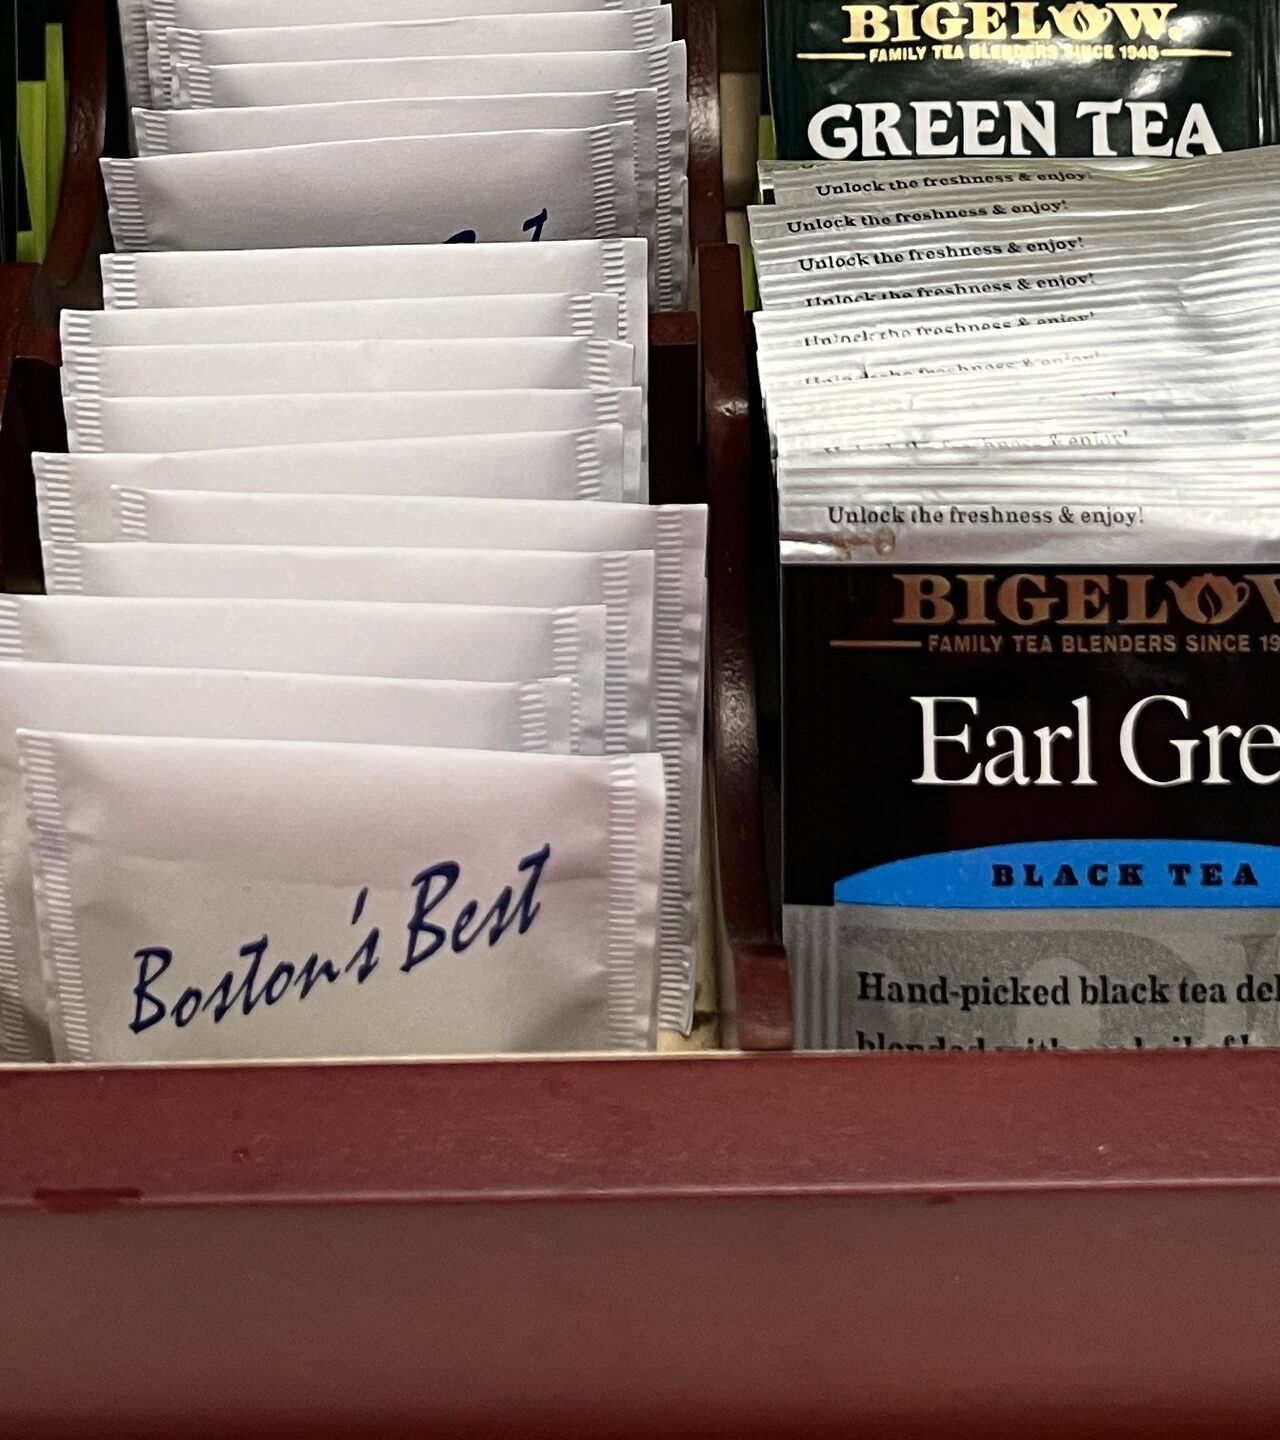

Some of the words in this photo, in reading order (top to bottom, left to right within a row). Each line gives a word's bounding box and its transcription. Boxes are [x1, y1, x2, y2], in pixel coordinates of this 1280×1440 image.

[870, 46, 926, 62] FAMILY
[932, 45, 964, 59] TEA
[1119, 45, 1160, 60] 1945
[808, 100, 1055, 160] GREEN
[1077, 98, 1223, 157] TEA
[816, 176, 884, 196] Unlock
[889, 175, 919, 190] the
[922, 173, 1013, 187] freshness
[1018, 172, 1032, 182] &
[786, 216, 856, 234] Unlock
[860, 214, 890, 228] the
[896, 207, 988, 224] freshness
[992, 204, 1007, 215] &
[1011, 200, 1068, 215] enjoy!
[798, 252, 869, 272] Unlock
[874, 251, 904, 264] the
[908, 244, 1002, 262] freshness
[1007, 242, 1022, 254] &
[828, 507, 912, 524] Unlock
[912, 506, 943, 523] the
[949, 506, 1052, 523] freshness
[1059, 506, 1074, 523] &
[1080, 507, 1143, 527] enjoy!
[928, 634, 1002, 652] FAMILY
[1012, 634, 1053, 652] TEA
[1062, 633, 1176, 652] BLENDERS
[1186, 633, 1251, 652] SINCE
[910, 694, 1098, 786] Earl
[992, 863, 1144, 887] BLACK
[1168, 863, 1258, 887] TEA
[128, 887, 380, 1034] Boston's
[399, 843, 551, 973] Best
[857, 971, 1071, 1010] Hand-picked
[1080, 975, 1171, 1004] black
[1179, 976, 1227, 1003] tea
